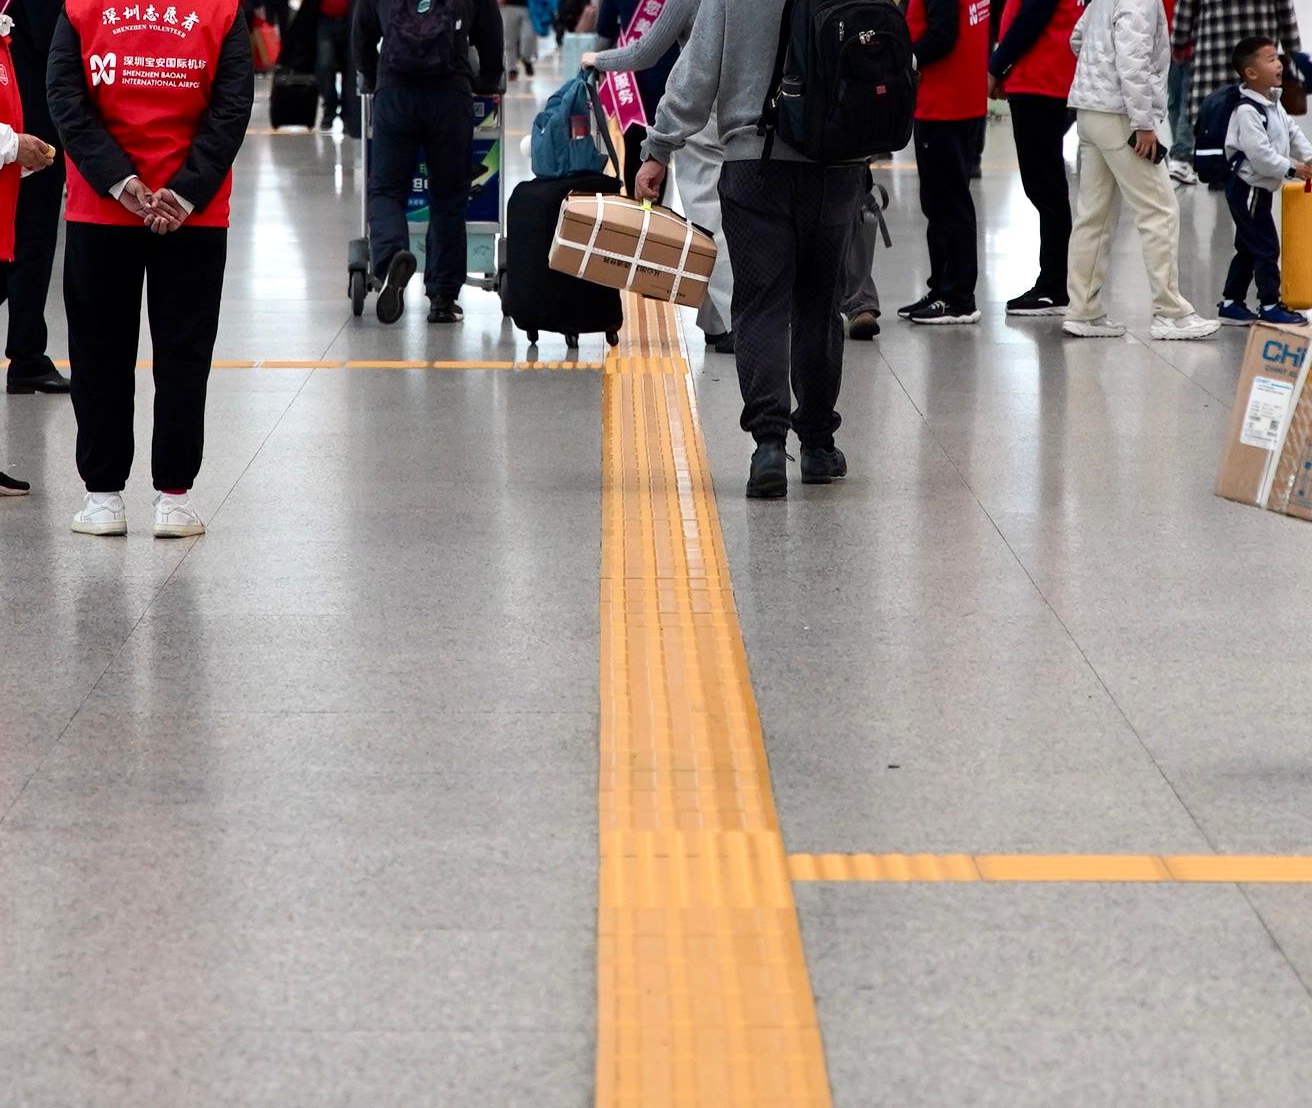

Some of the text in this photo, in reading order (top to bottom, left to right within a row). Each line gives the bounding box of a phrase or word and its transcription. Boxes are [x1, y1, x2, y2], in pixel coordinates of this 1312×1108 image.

[102, 4, 200, 31] 深圳志愿者
[112, 23, 147, 35] SHENZHEN
[122, 69, 187, 79] SHENZHEN BAOAN
[121, 77, 177, 88] INTERNATIONAL
